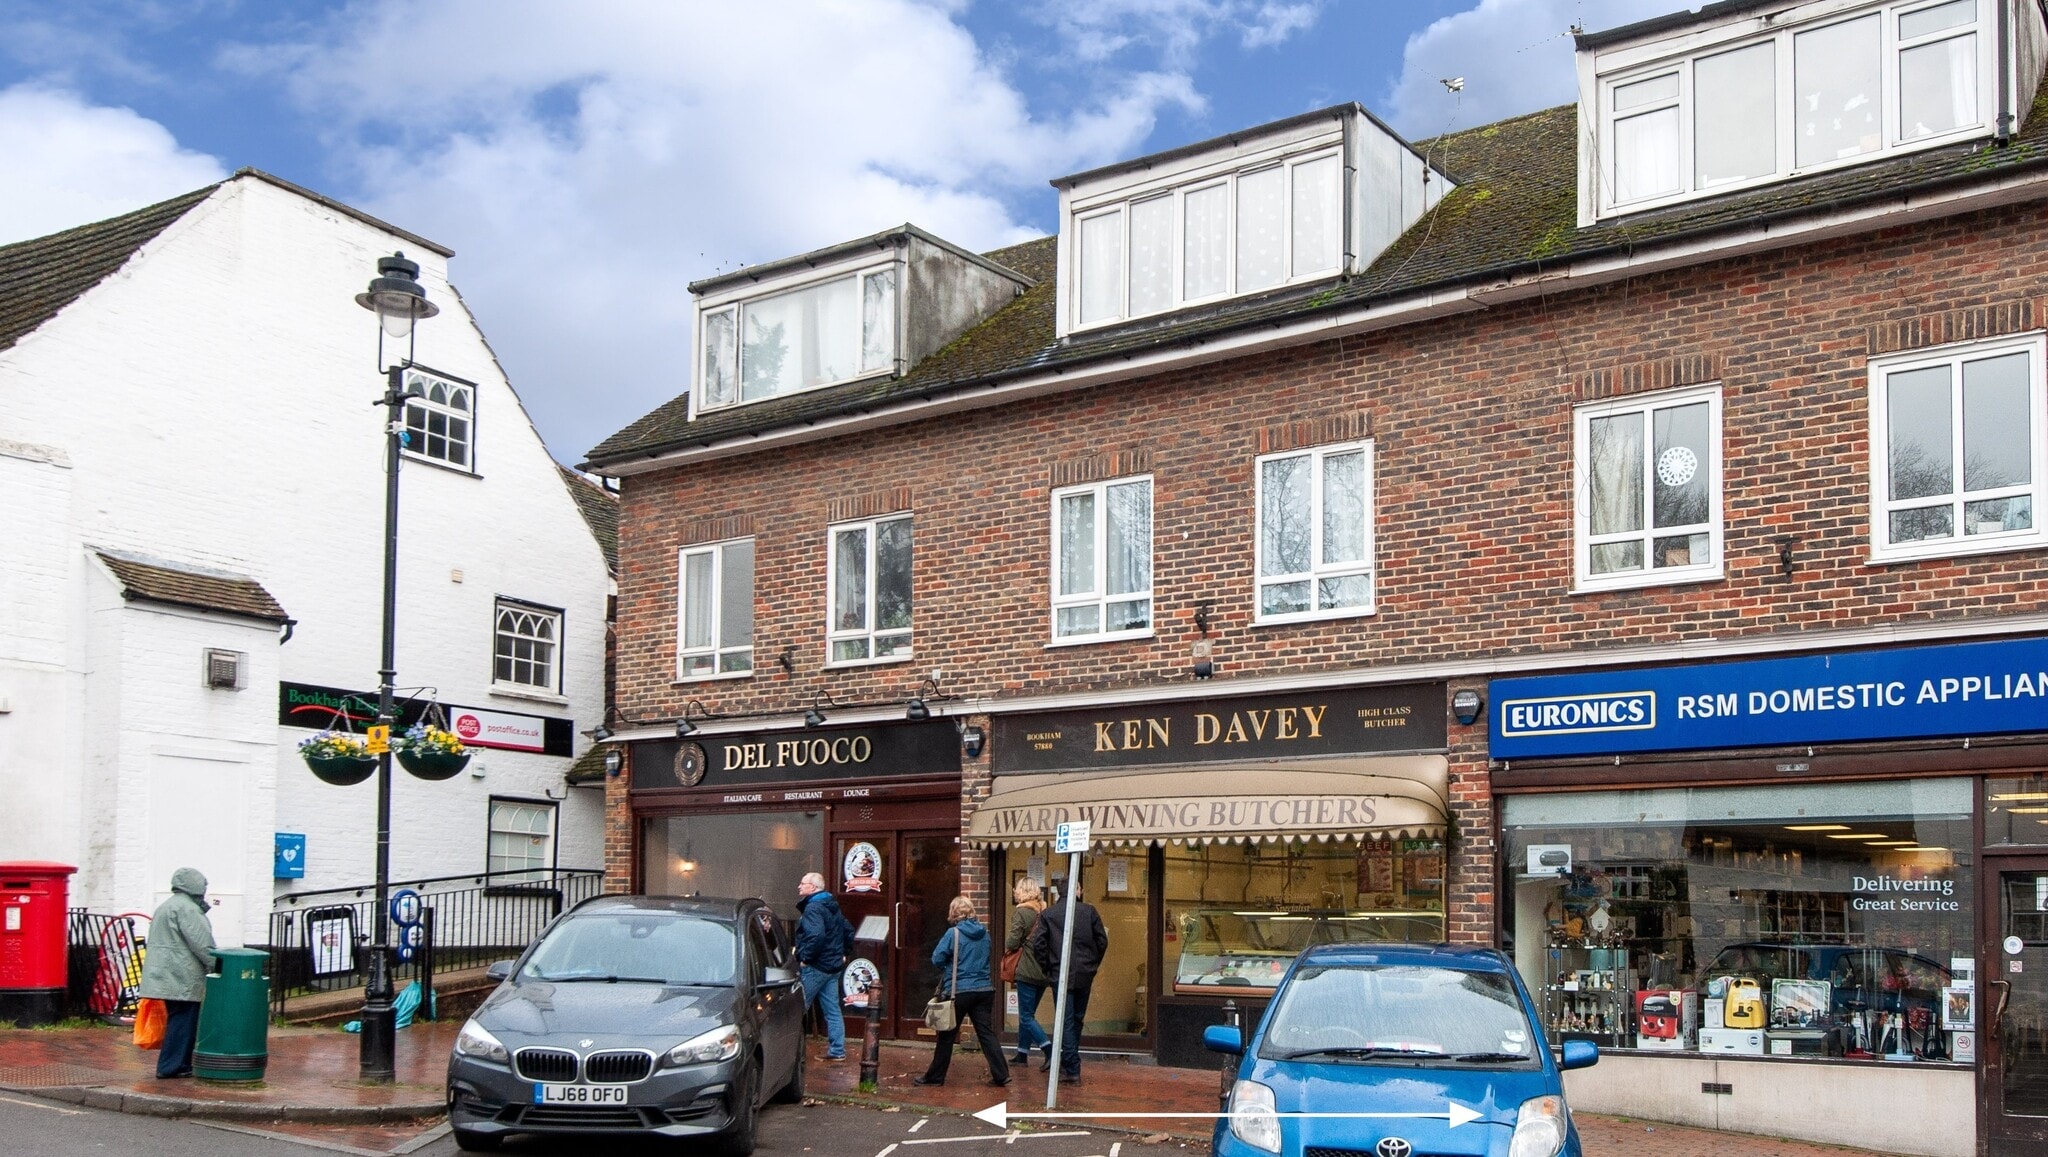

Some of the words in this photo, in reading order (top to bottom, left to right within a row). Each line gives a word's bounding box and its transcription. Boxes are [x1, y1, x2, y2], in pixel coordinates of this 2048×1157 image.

[288, 688, 353, 709] Bookham
[1511, 699, 1645, 728] EURONICS
[1677, 693, 1738, 719] RSM
[1749, 681, 1906, 715] DOMESTIC
[1357, 708, 1381, 718] HIGH
[1383, 706, 1411, 716] CLASS
[458, 725, 479, 733] OFFICE
[1094, 717, 1171, 752] KEN
[1193, 705, 1328, 745] DAVEY
[1364, 718, 1407, 728] BUTCHER
[487, 725, 540, 737] postoffice.co.uk
[1026, 731, 1062, 741] BOOKHAM
[723, 743, 772, 770] DEL
[776, 736, 872, 767] FUOCO
[723, 795, 747, 803] ITALIAN
[747, 794, 762, 802] CAFE
[784, 791, 823, 800] RESTAURANT
[843, 789, 870, 797] LOUNGE
[988, 806, 1069, 834] AWARD
[1078, 802, 1200, 829] WINNING
[1208, 797, 1377, 827] BUTCHERS
[1852, 875, 1954, 895] Delivering
[1852, 897, 1896, 911] Great
[1900, 897, 1959, 911] Service
[545, 1086, 588, 1102] LJ68
[592, 1087, 624, 1102] OFO
